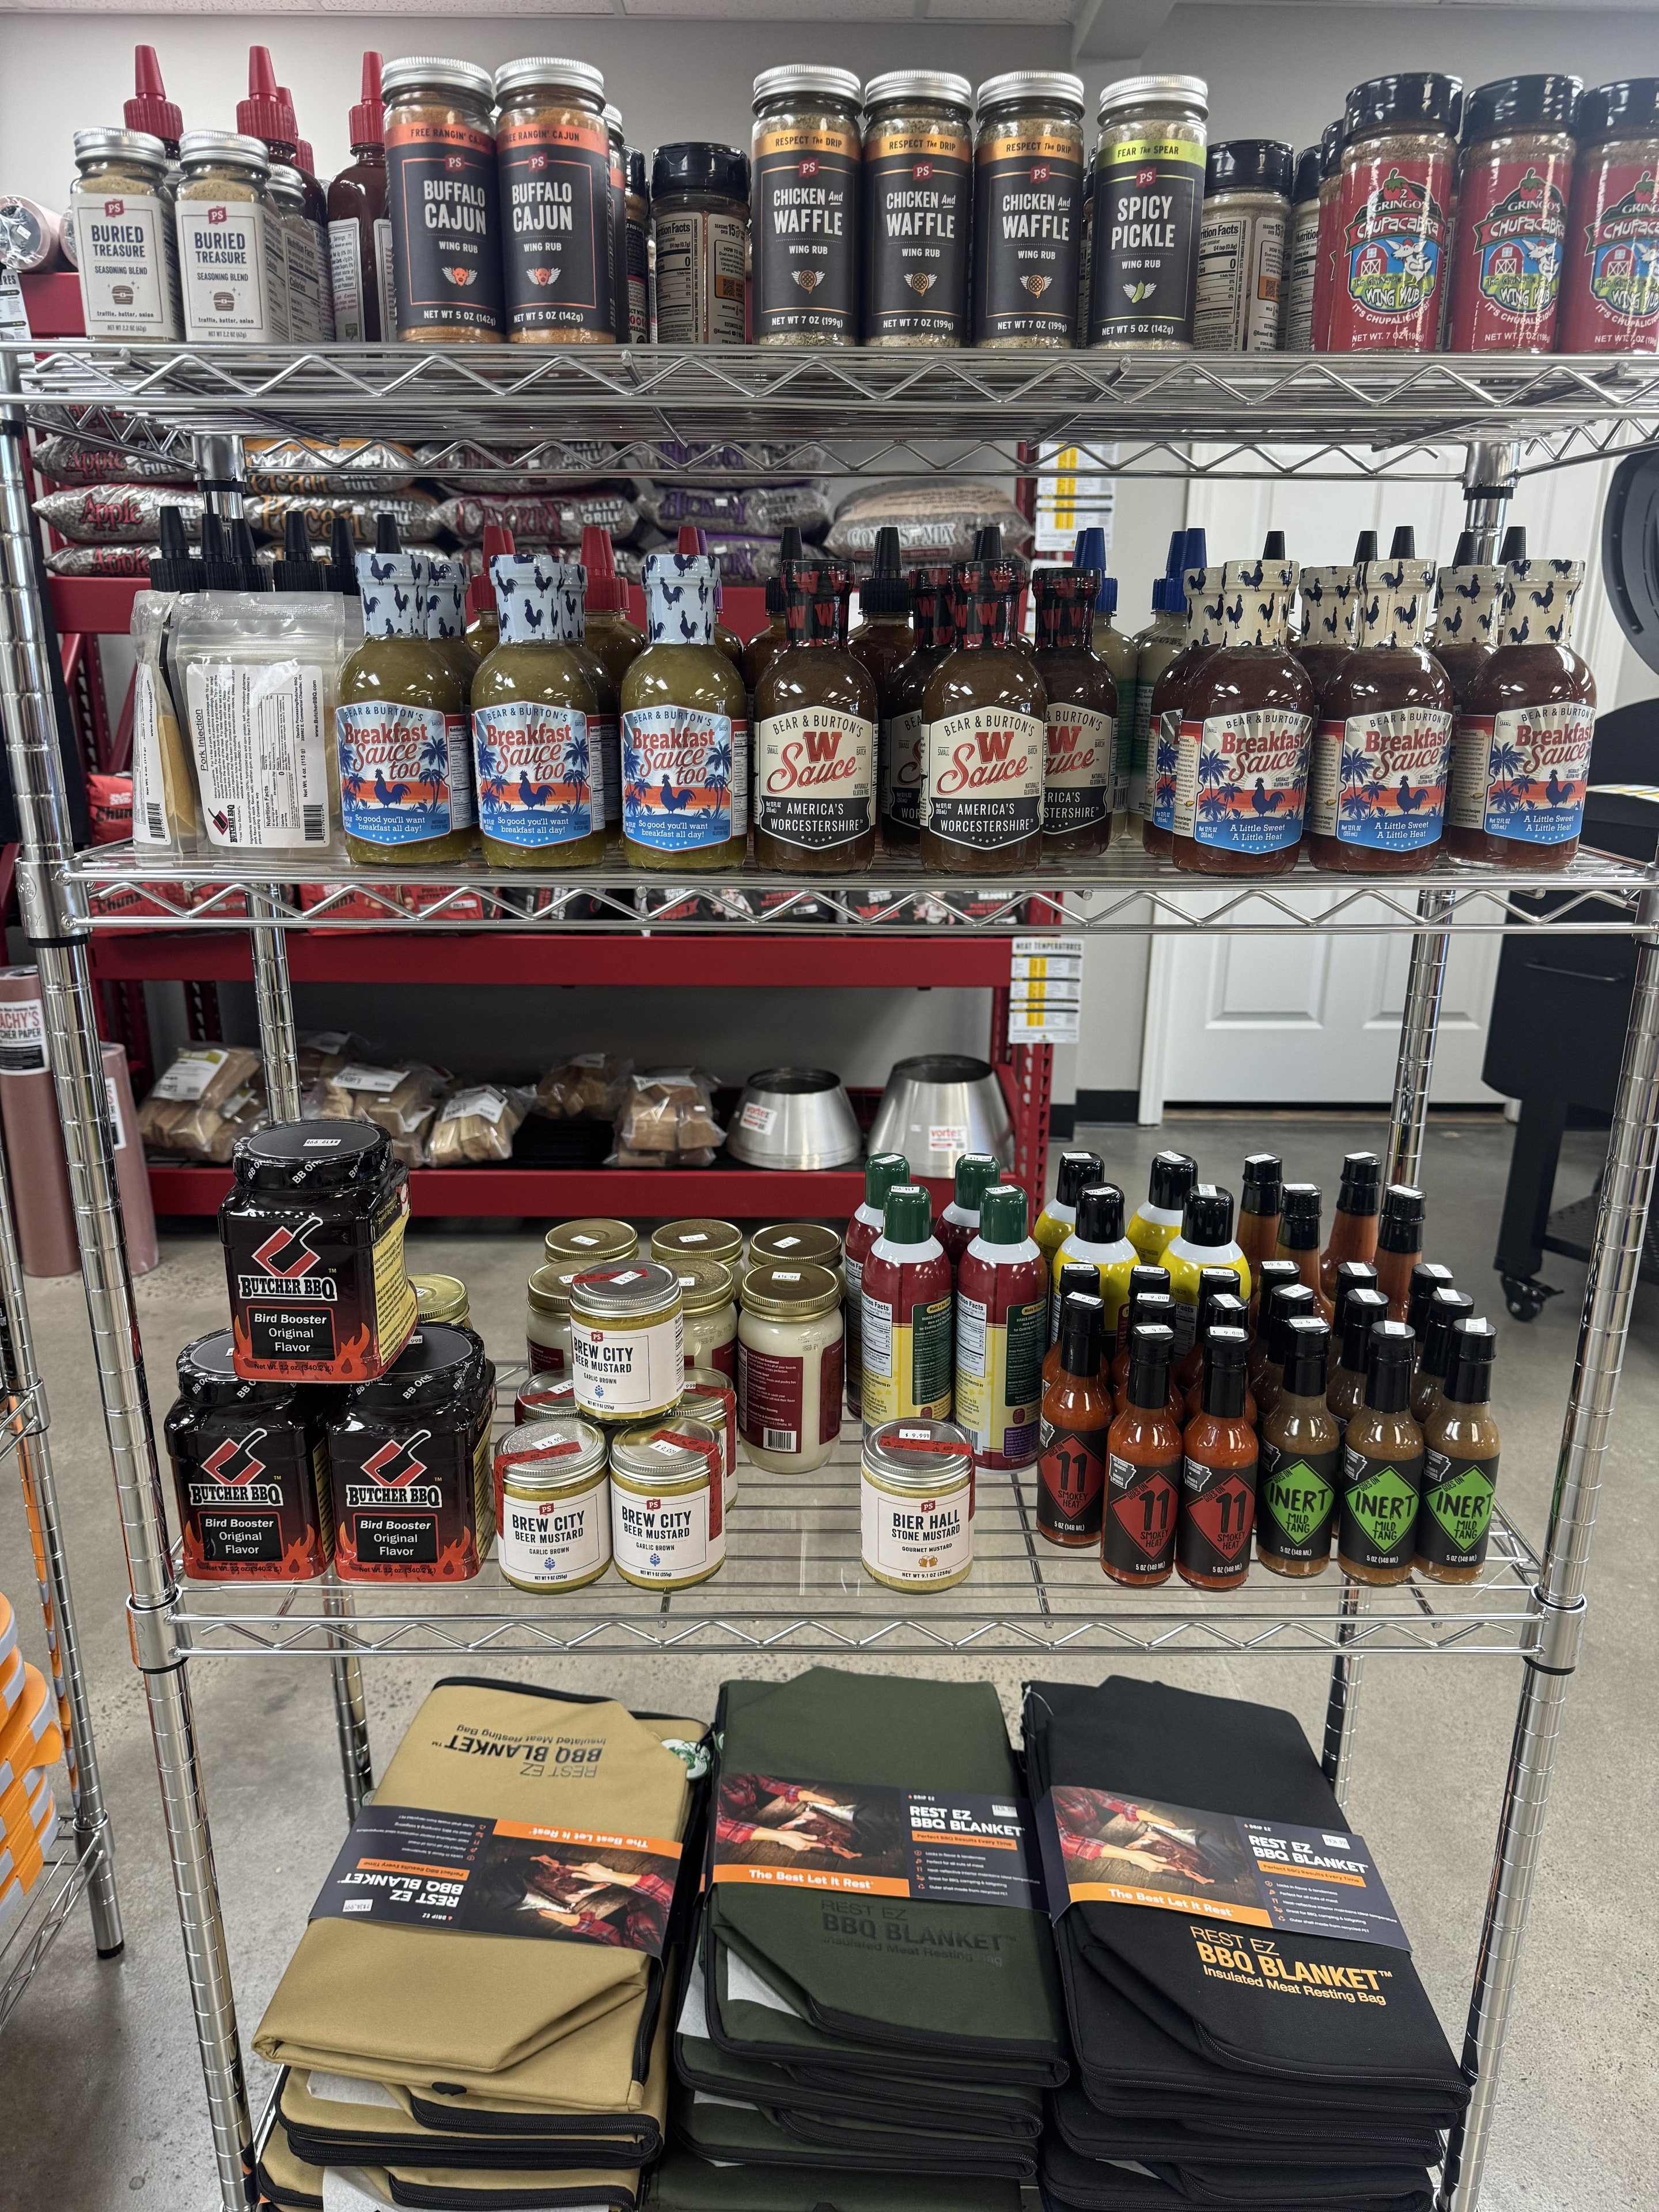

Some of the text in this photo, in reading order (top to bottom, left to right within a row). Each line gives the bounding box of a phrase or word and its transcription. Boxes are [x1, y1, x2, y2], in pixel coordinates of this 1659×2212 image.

[411, 128, 466, 142] FREE RANGIN'
[775, 137, 809, 146] RESPECT
[826, 138, 842, 147] DRIP
[1118, 147, 1137, 158] FEAR
[1154, 146, 1179, 155] SPEAR
[423, 180, 486, 207] BUFFALO
[774, 188, 843, 206] CHICKEN And
[1399, 189, 1407, 198] 2
[108, 203, 120, 213] PS
[1117, 195, 1173, 221] SPICY
[425, 203, 486, 235] CAJUN
[774, 209, 843, 236] WAFFLE
[92, 225, 144, 243] BURIED
[1111, 224, 1175, 250] PICKLE
[1218, 225, 1238, 234] Facts
[93, 244, 146, 257] TREASURE
[439, 241, 478, 253] WING RUB
[789, 245, 828, 255] WING RUB
[94, 266, 147, 275] SEASONING BLEND
[1122, 260, 1161, 269] WING RUB
[1365, 287, 1420, 307] WING WUB
[1352, 304, 1365, 317] IT'S
[772, 316, 785, 325] NET
[787, 316, 799, 325] WT
[809, 316, 819, 324] OZ
[822, 316, 843, 328] (199g)
[80, 497, 142, 534] Apple
[346, 707, 362, 719] BEAR
[374, 707, 423, 721] BURTON'S
[1226, 717, 1252, 729] BEAR
[1265, 715, 1304, 728] BURTON'S
[345, 722, 428, 744] Breakfast
[773, 715, 863, 737] BEAR & BURTON'S
[195, 709, 207, 771] Pork Injection
[802, 732, 842, 763] W
[1221, 729, 1305, 754] Breakfast
[353, 743, 417, 772] Sauce
[767, 747, 778, 755] SMALL
[390, 761, 421, 780] too
[766, 742, 857, 794] Sauce
[1228, 750, 1297, 782] Sauce
[787, 803, 843, 815] AMERICA'S
[226, 805, 237, 843] BUTCHER BBQ
[358, 823, 391, 831] breakfast
[404, 824, 422, 833] day!
[383, 816, 403, 824] you'll
[0, 1011, 39, 1028] ACHY'S
[18, 1028, 41, 1037] PAPER
[241, 1278, 335, 1298] BUTCHER BBQ
[254, 1313, 327, 1324] Bird Booster
[268, 1328, 314, 1339] Original
[275, 1342, 310, 1352] Flavor
[1139, 1489, 1169, 1531] 11
[1355, 1491, 1415, 1520] INERT
[513, 1510, 585, 1532] BREW CITY
[893, 1510, 960, 1530] BIER HALL
[1374, 1521, 1396, 1531] MILD
[515, 1527, 584, 1544] BEER MUSTARD
[892, 1524, 960, 1541] STONE MUSTARD
[1140, 1529, 1169, 1540] SMOKEY
[1373, 1529, 1397, 1540] TANG
[550, 1546, 569, 1554] BROWN
[929, 1543, 952, 1552] MUSTARD
[1146, 1539, 1162, 1548] HEAT
[555, 1747, 602, 1763] BBQ
[910, 1806, 972, 1820] REST EZ
[911, 1817, 1023, 1836] BBQ BLANKET
[1108, 1888, 1232, 1916] The Best Let It Rest
[1190, 1926, 1279, 1956] REST EZ
[1196, 1942, 1254, 1975] BBQ
[1203, 1965, 1386, 2006] Insulated Meat Resting Bag
